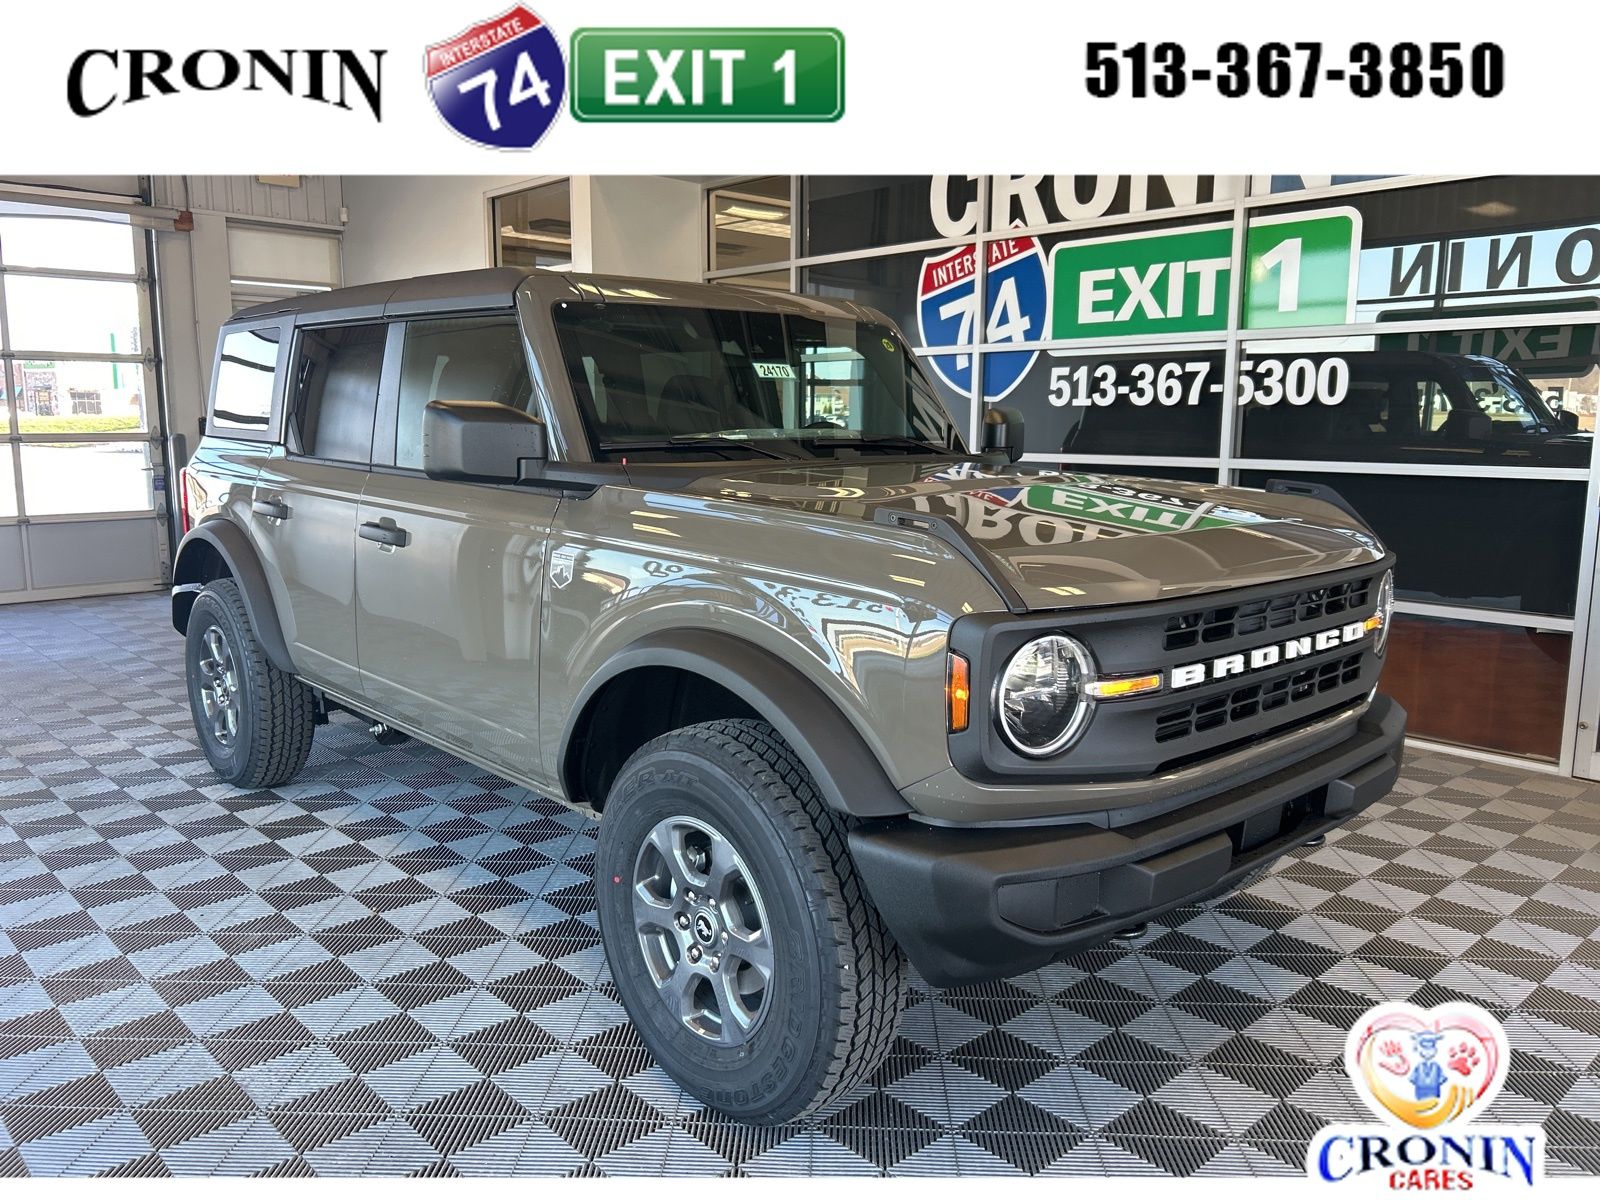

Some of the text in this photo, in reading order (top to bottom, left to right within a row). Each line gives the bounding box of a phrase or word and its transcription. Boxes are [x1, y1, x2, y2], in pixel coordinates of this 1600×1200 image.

[932, 239, 1020, 288] INTERATE
[1077, 237, 1303, 325] EXIT 1
[939, 276, 1031, 372] 74
[759, 364, 790, 378] 24170
[1047, 356, 1351, 408] 513-367-5300
[1171, 621, 1365, 689] BRONCO
